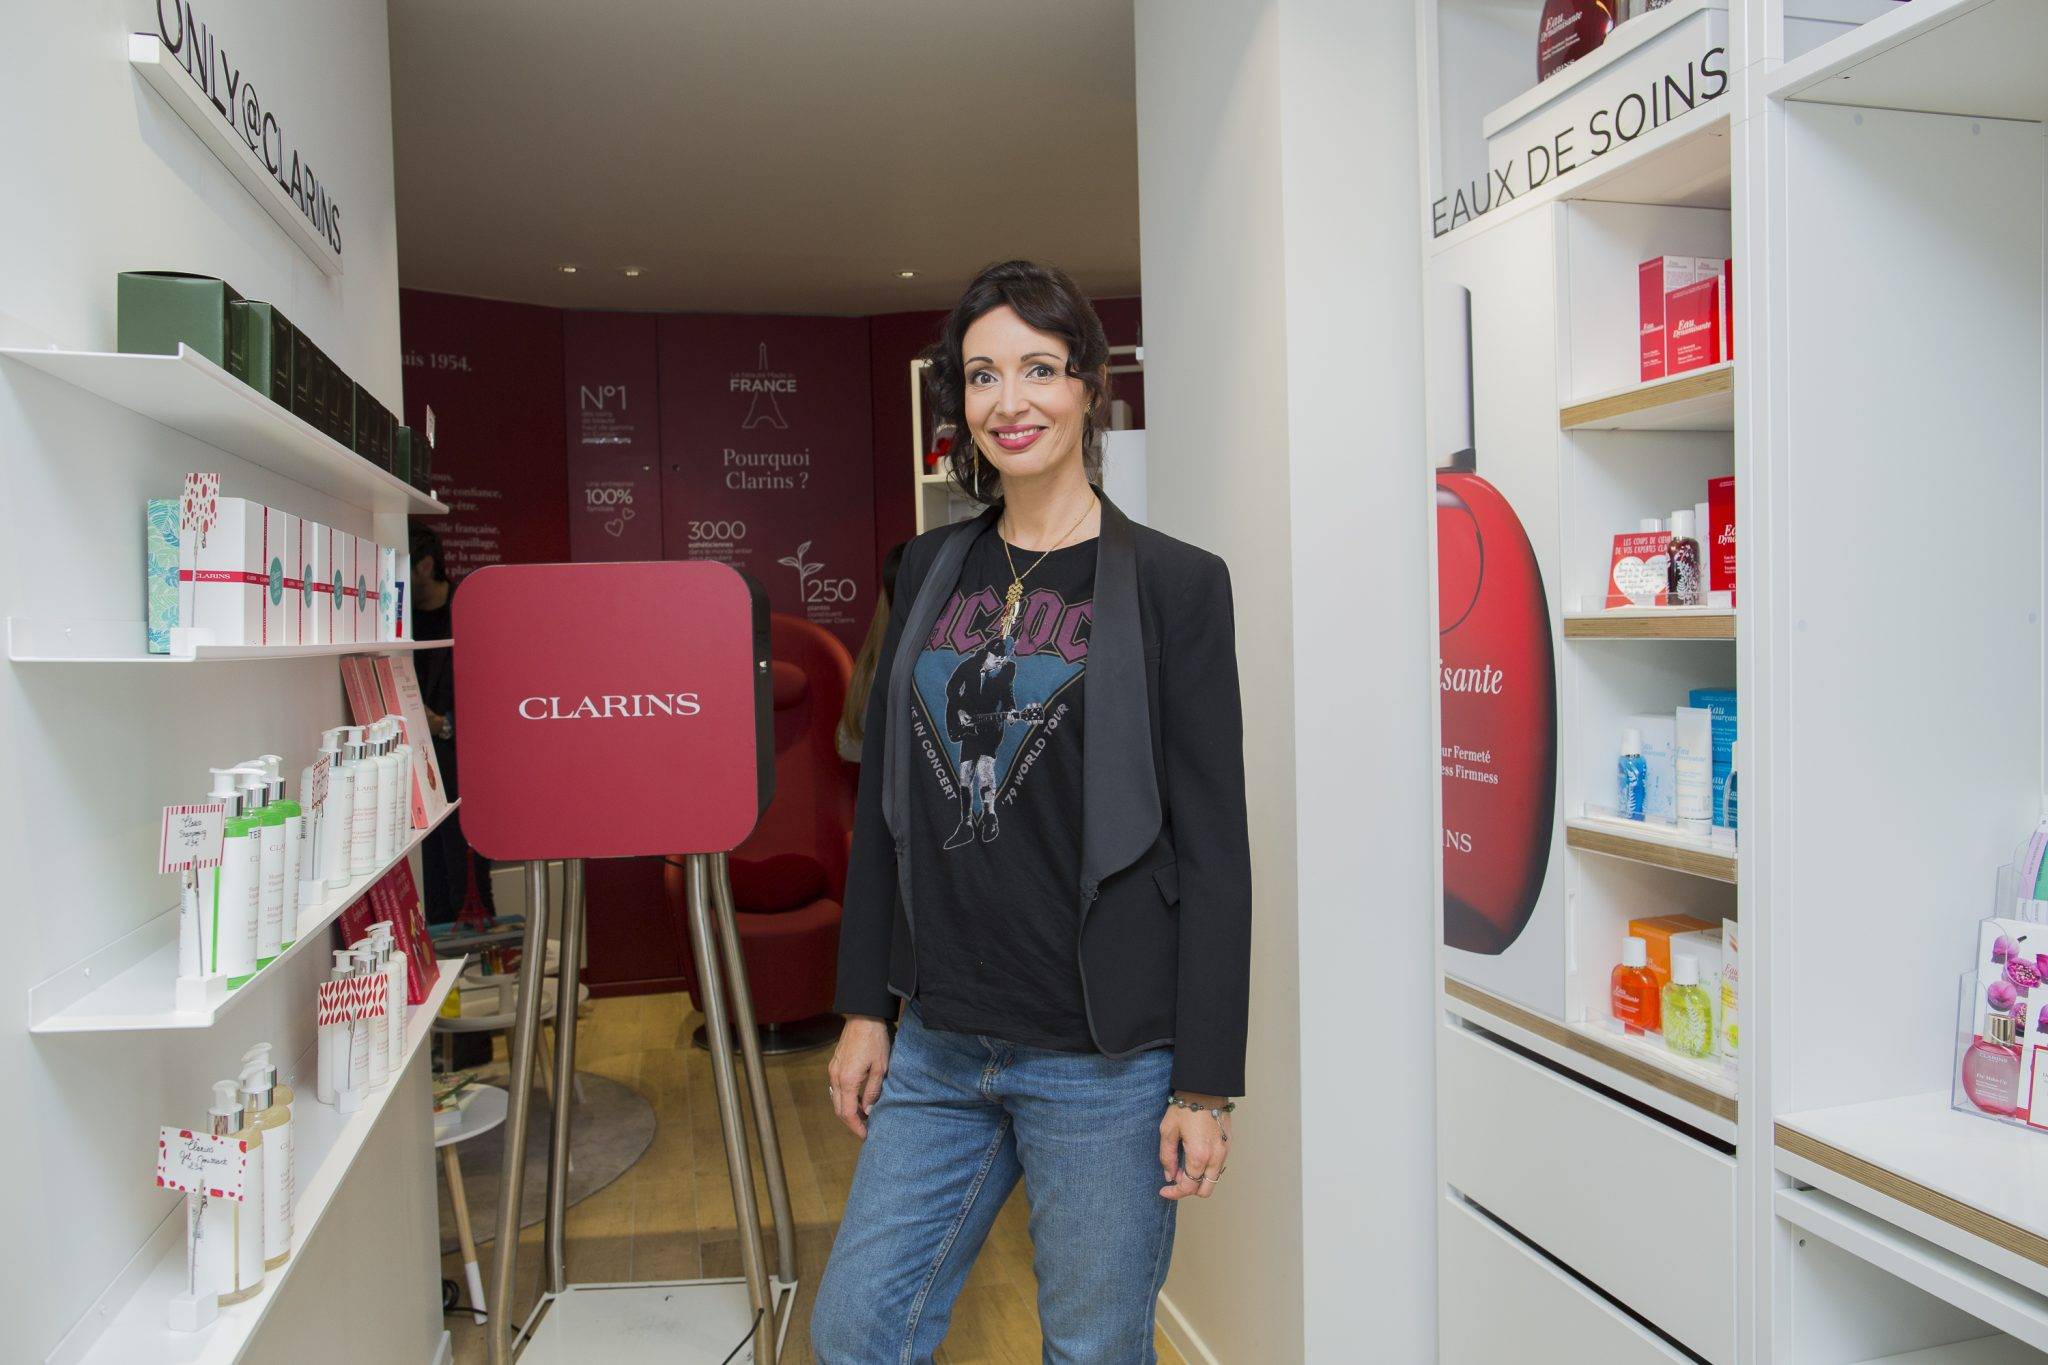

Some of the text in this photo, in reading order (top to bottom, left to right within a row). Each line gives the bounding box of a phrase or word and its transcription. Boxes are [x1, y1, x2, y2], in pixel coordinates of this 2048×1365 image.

[1432, 47, 1729, 239] EAUX DE SOINS
[430, 353, 473, 372] 1954.
[730, 379, 797, 393] FRANCE
[723, 447, 811, 472] Pourquoi
[726, 471, 809, 490] Clarins ?
[585, 488, 633, 506] 100%
[688, 520, 746, 540] 3000
[807, 578, 856, 602] 250
[518, 693, 701, 720] CLARINS
[1014, 737, 1046, 787] WORLD
[1043, 703, 1070, 736] TOUR
[1453, 745, 1491, 764] Fermeté
[914, 720, 957, 801] IN CONCERT
[1455, 764, 1499, 785] Firmness
